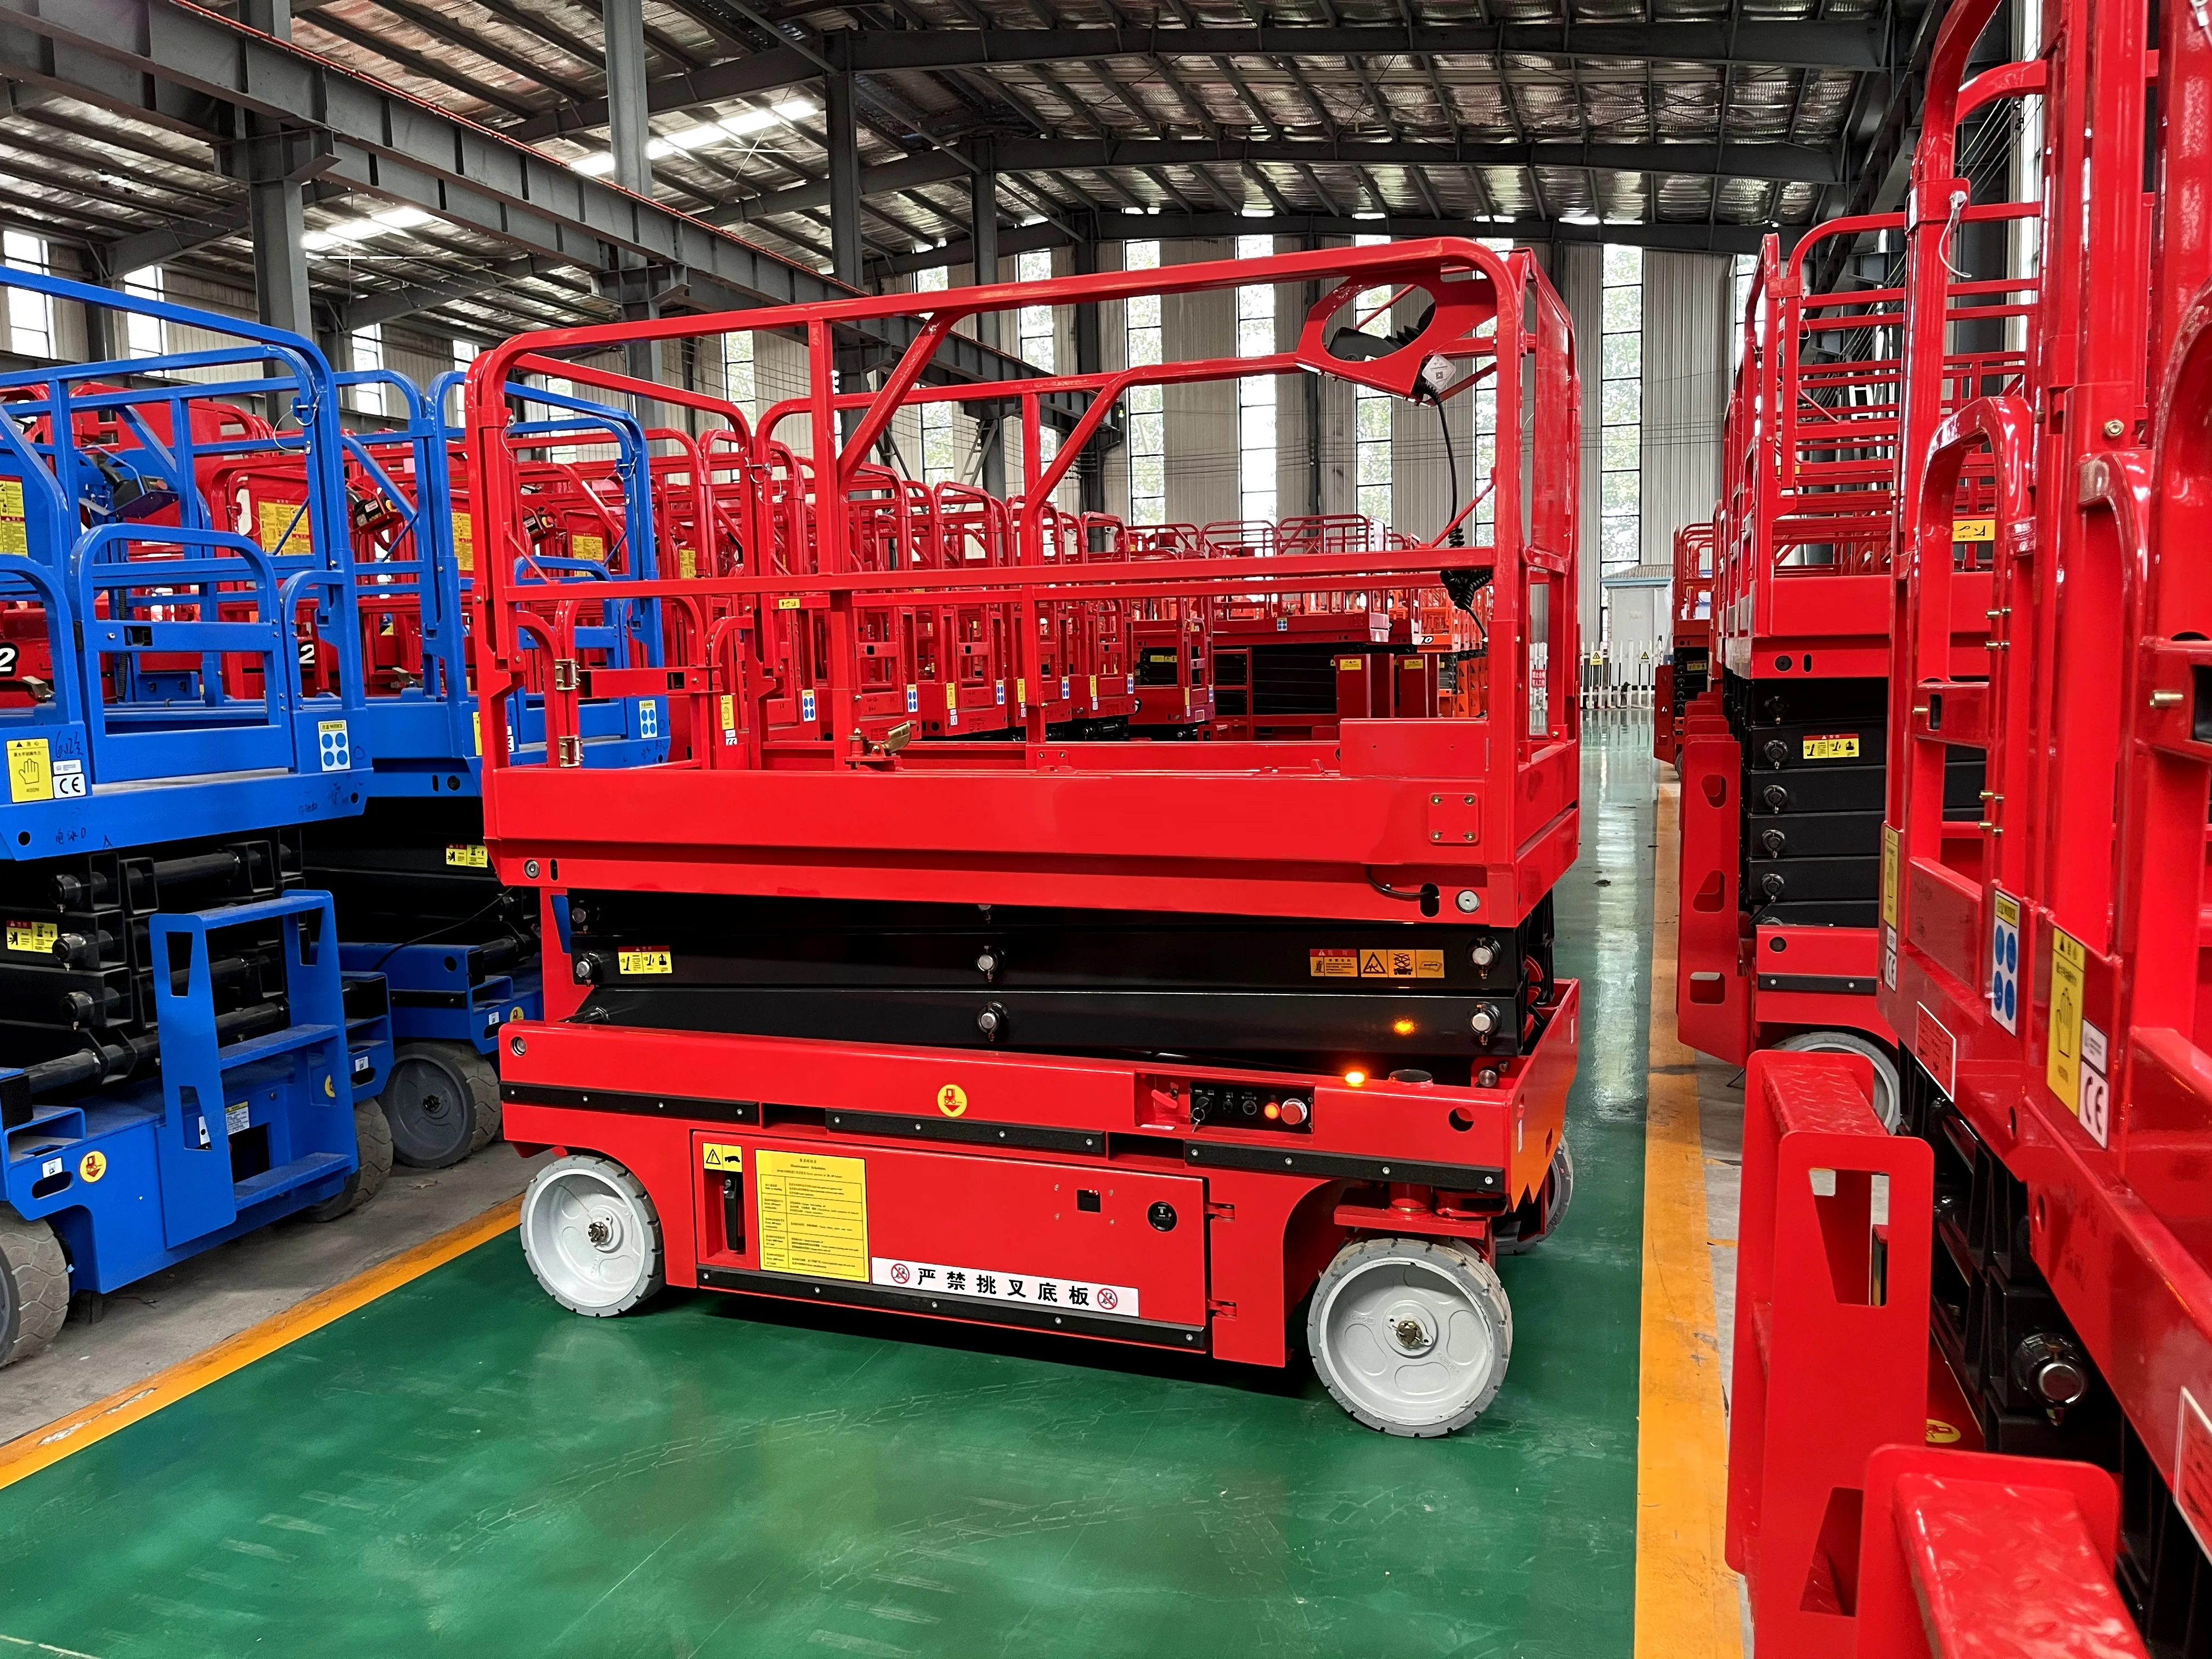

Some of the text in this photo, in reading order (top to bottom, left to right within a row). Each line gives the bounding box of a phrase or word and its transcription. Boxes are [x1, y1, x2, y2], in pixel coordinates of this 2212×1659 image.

[0, 647, 15, 672] 2
[299, 644, 315, 664] 2
[59, 776, 81, 794] CE
[2085, 1076, 2103, 1136] CE
[917, 1267, 1090, 1307] 严禁挑叉底板
